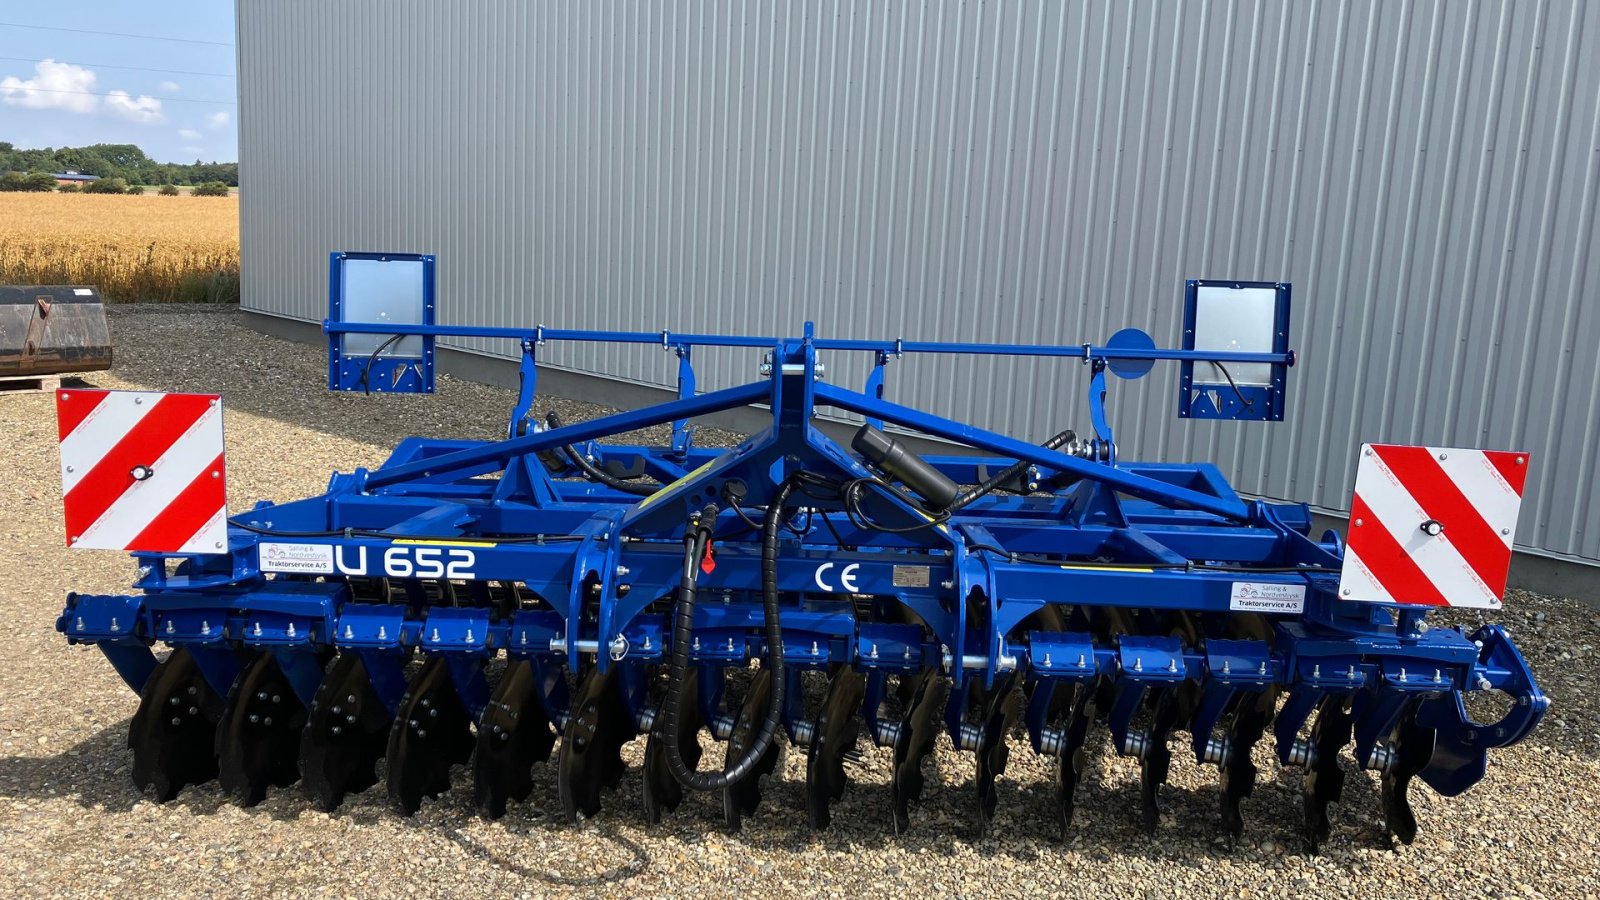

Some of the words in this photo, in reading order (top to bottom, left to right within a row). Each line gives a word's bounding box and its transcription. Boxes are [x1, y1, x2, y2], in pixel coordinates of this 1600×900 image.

[384, 547, 476, 579] 652
[815, 562, 860, 592] CE
[1239, 600, 1285, 608] Traktorservice
